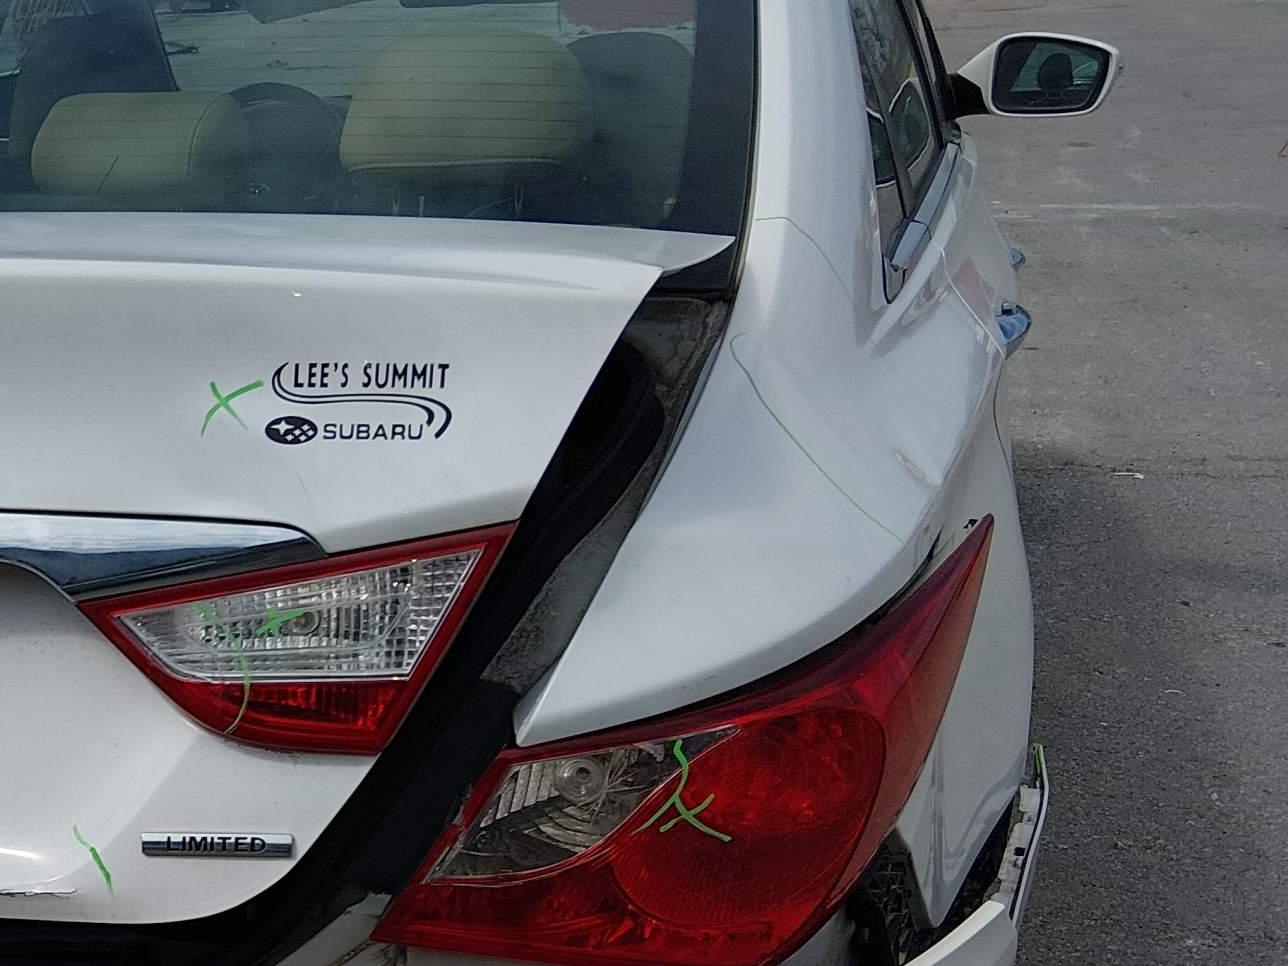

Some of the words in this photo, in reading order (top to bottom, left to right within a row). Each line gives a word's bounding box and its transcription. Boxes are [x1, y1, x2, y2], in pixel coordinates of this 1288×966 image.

[293, 362, 349, 388] LEE'S
[362, 362, 450, 389] SUMMIT
[322, 423, 424, 440] SUBARU
[166, 835, 267, 853] LIMITED
